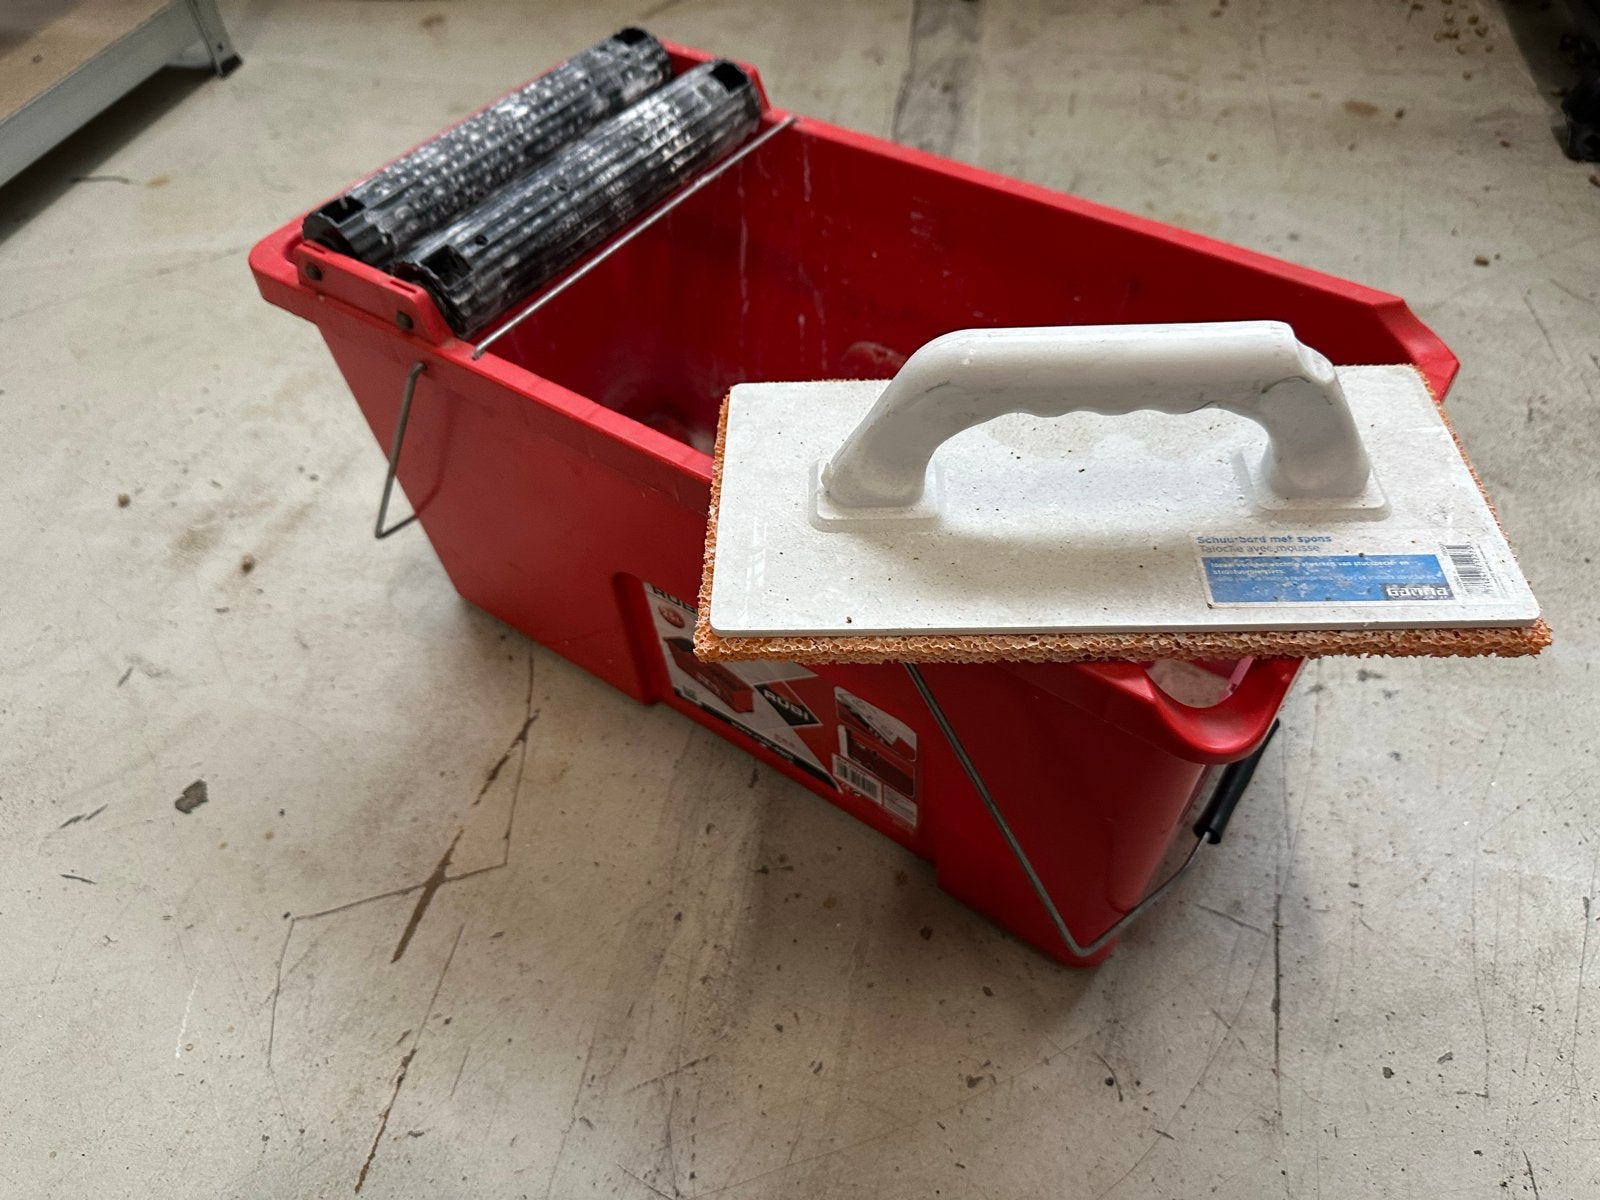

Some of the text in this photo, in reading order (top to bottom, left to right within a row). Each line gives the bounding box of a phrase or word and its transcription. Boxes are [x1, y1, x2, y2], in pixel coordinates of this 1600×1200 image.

[1197, 535, 1332, 545] Schuurbord met spons
[1246, 545, 1273, 553] avec
[1276, 545, 1320, 553] mousse
[763, 689, 809, 721] RUBI
